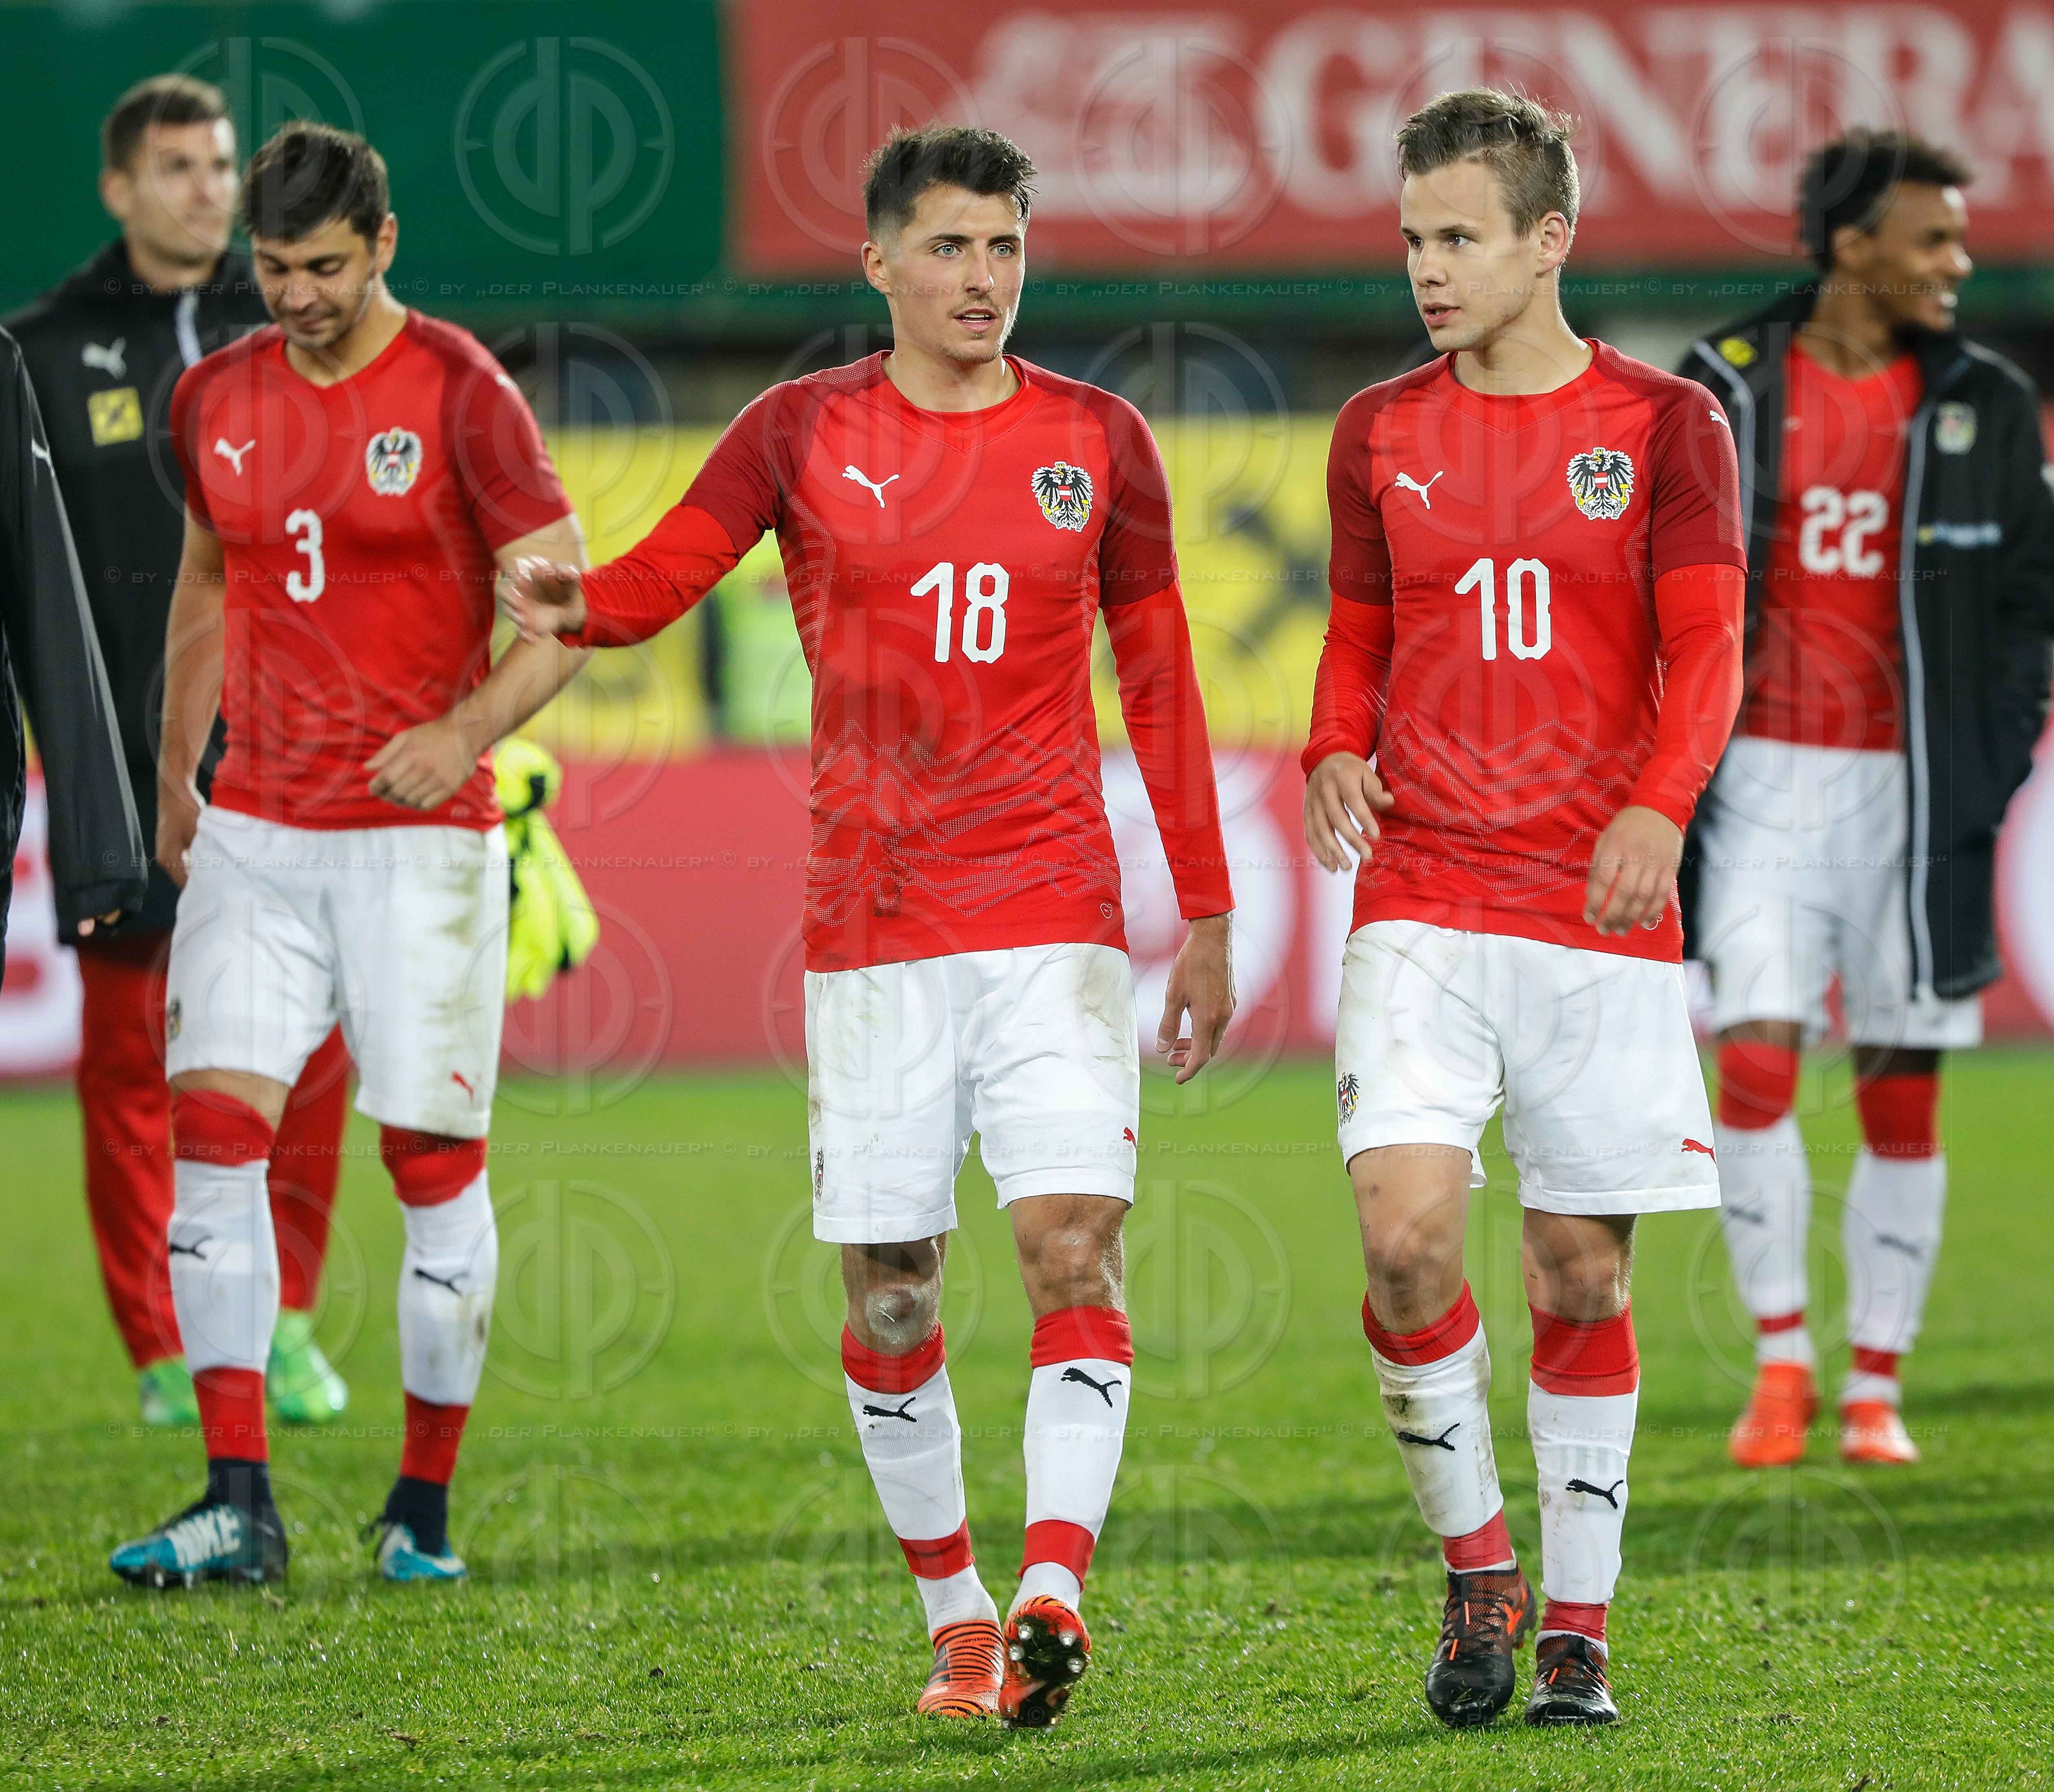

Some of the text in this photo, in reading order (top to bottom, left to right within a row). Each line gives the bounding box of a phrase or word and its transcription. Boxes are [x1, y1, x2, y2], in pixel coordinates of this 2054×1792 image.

[285, 508, 325, 602] 3
[1800, 484, 1890, 578] 22
[910, 562, 1009, 664] 18
[1454, 558, 1552, 660] 10
